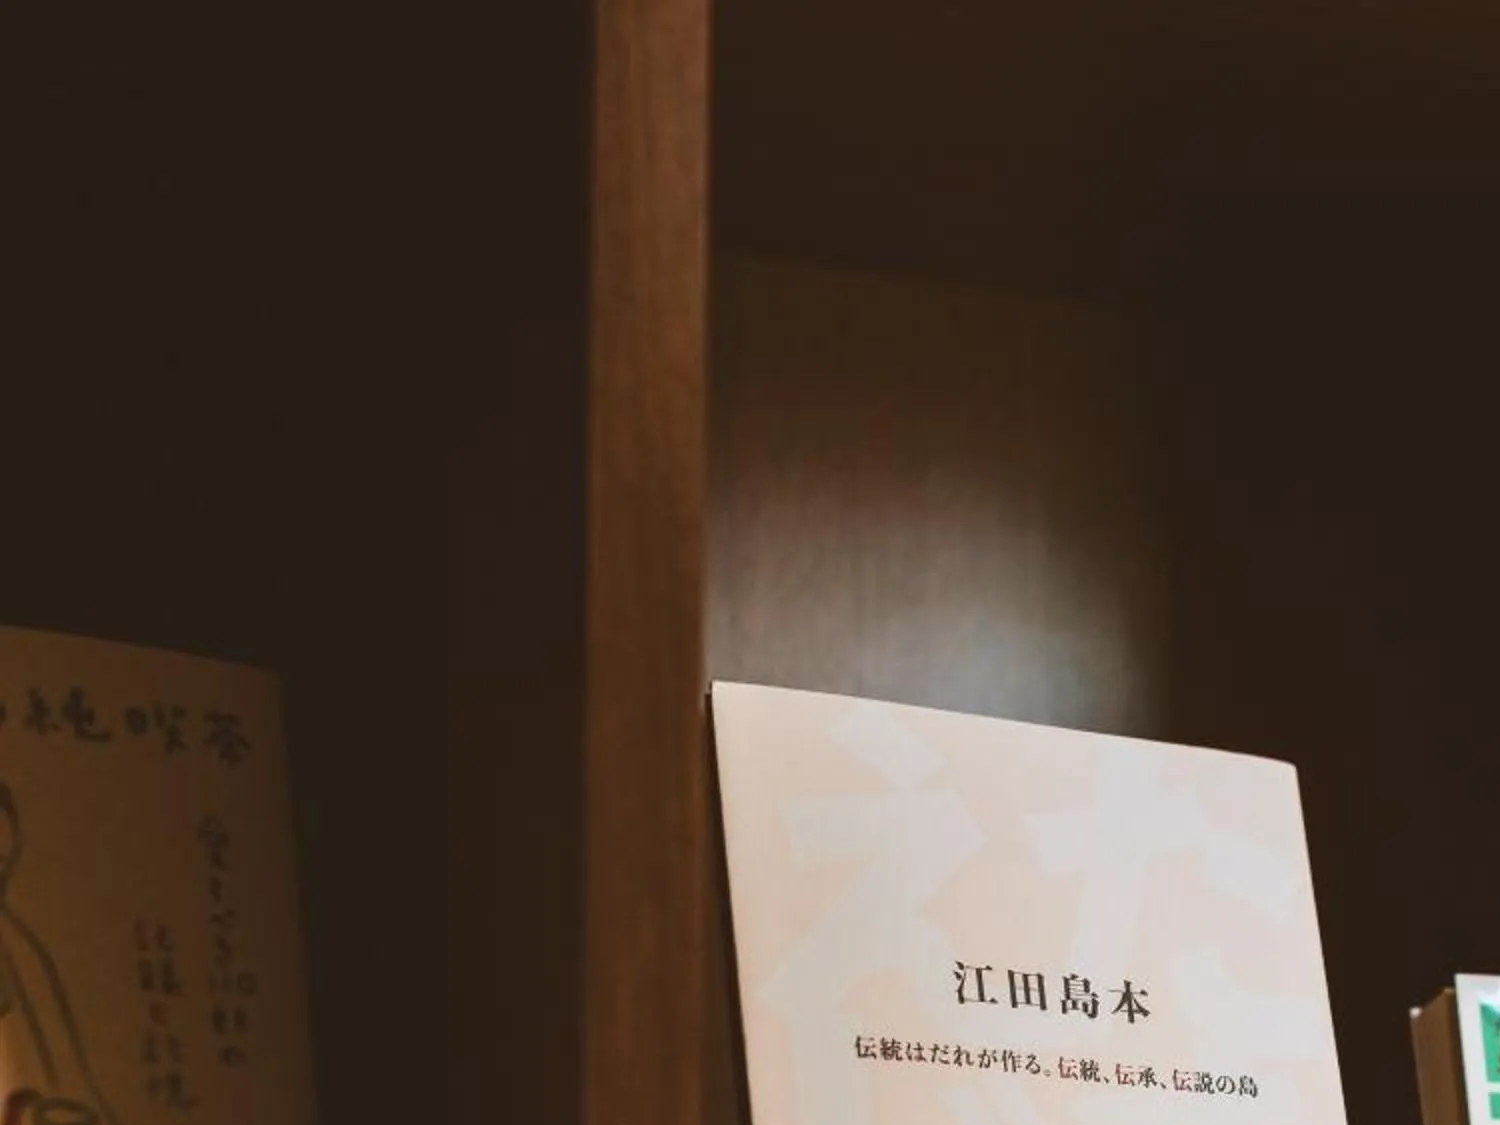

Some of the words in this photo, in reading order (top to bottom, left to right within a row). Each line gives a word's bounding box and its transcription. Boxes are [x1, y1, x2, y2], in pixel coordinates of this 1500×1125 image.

[0, 684, 254, 766] 純喫茶
[953, 960, 1151, 1024] 江田島本
[854, 1034, 1259, 1099] 伝統はだれが作る。伝統、伝承、伝説の島
